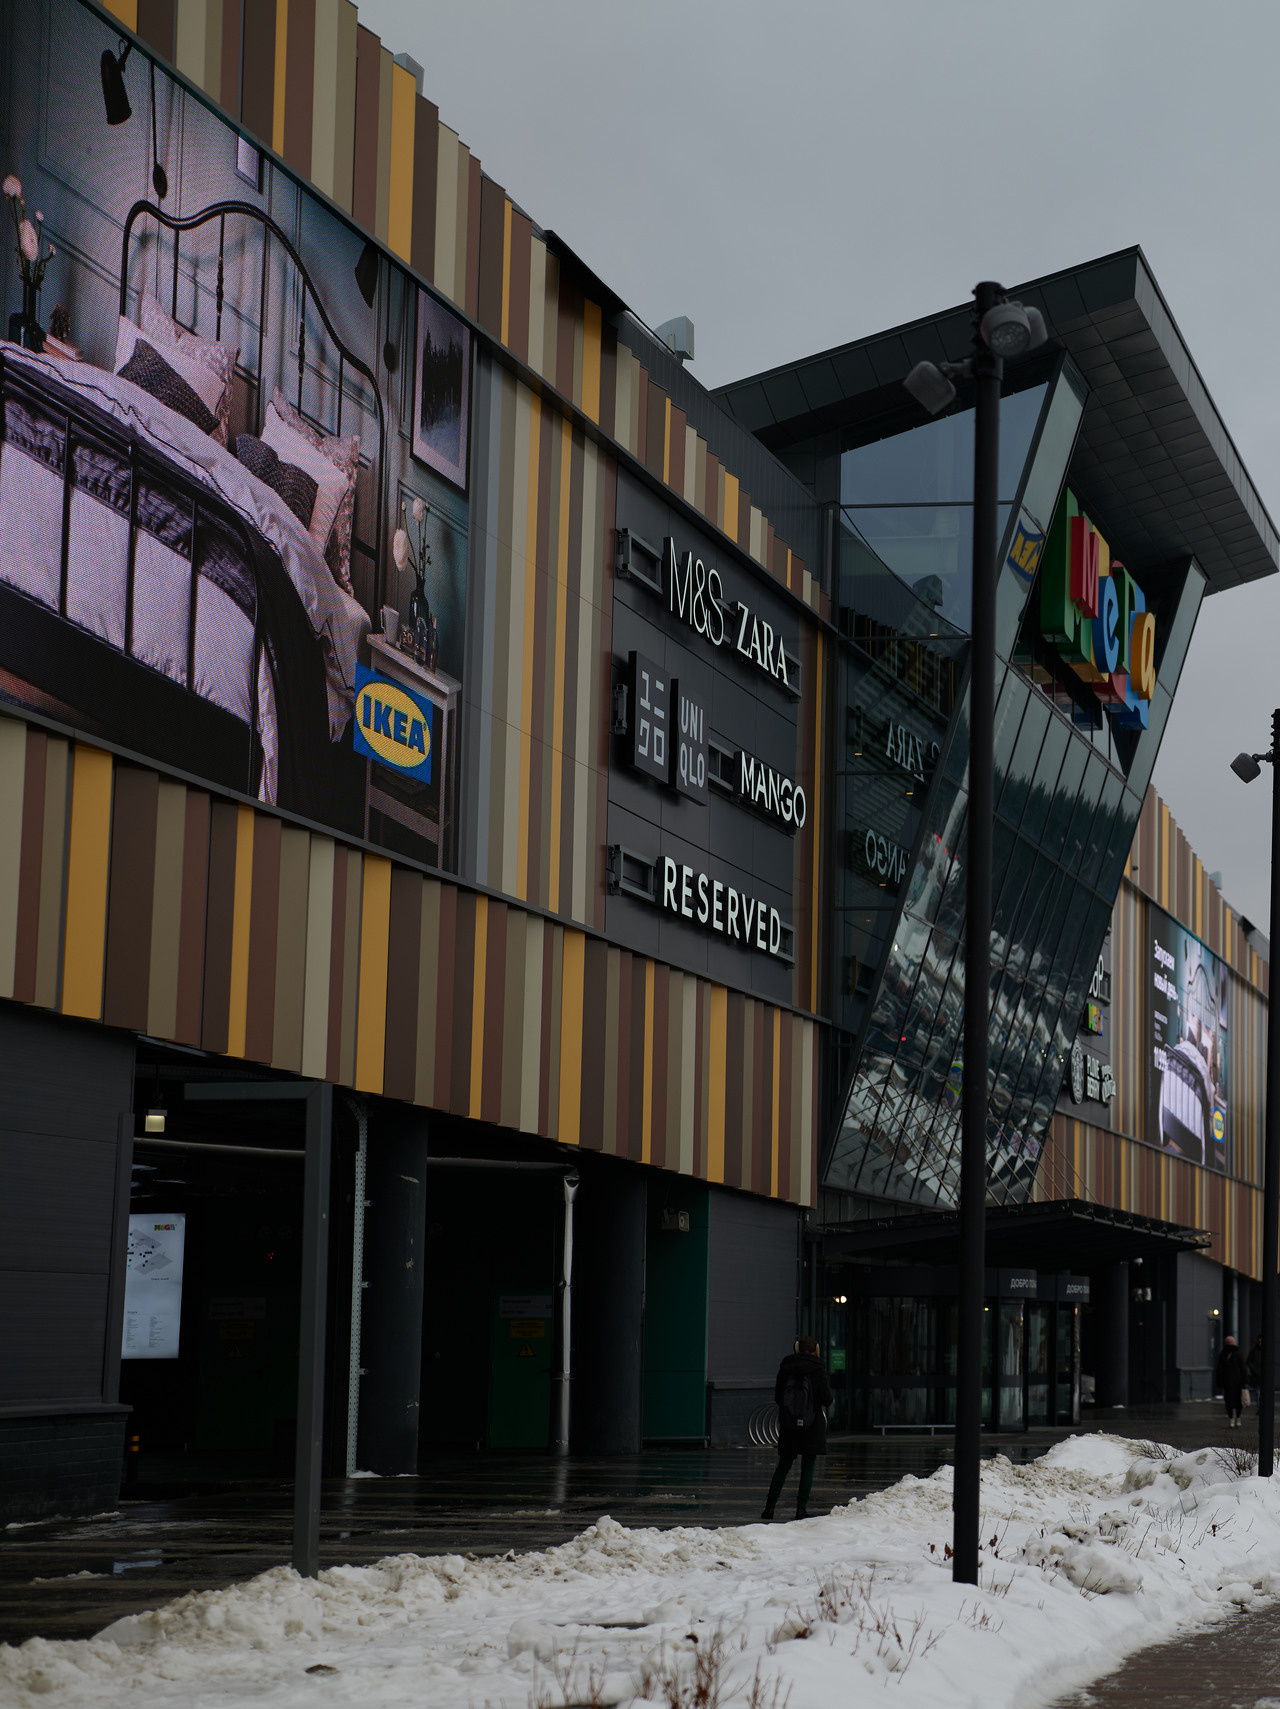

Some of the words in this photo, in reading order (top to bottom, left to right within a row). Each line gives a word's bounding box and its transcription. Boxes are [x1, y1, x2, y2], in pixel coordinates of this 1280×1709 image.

[669, 536, 724, 646] M&S
[737, 600, 789, 687] ZARA
[362, 693, 426, 755] IKEA
[681, 695, 704, 744] UNI
[680, 742, 705, 788] QLO
[741, 750, 807, 829] MANGO
[663, 855, 781, 955] RESERVED
